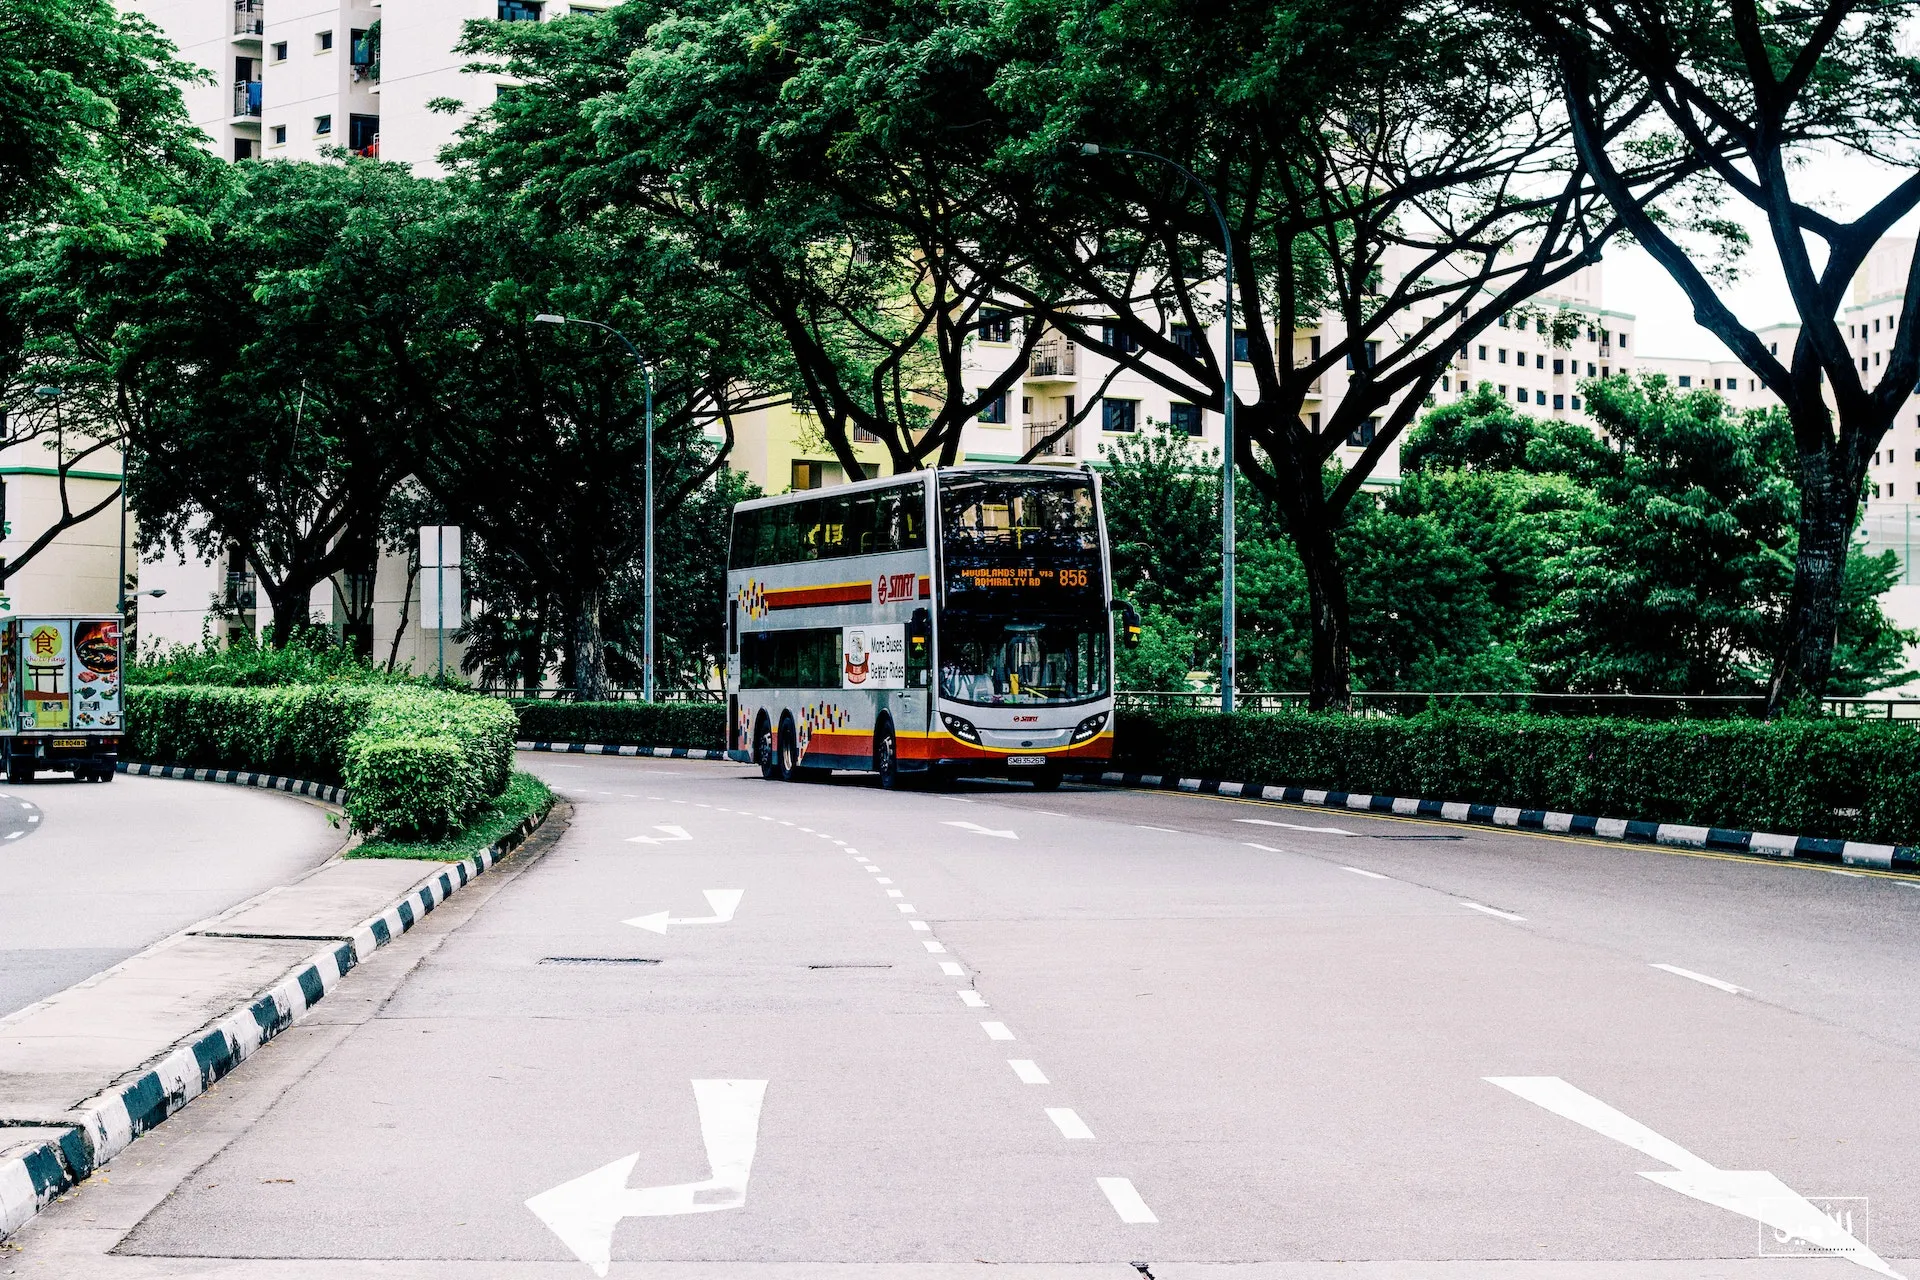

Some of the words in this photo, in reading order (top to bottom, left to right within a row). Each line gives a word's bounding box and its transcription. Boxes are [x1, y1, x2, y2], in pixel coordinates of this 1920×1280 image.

[1017, 569, 1034, 577] INT
[1059, 569, 1087, 587] 856
[887, 573, 915, 599] SMRT
[974, 578, 1026, 586] ADMIRALTY
[1028, 578, 1040, 586] RD
[871, 637, 885, 653] More
[871, 662, 888, 679] Better
[889, 661, 904, 678] Rides
